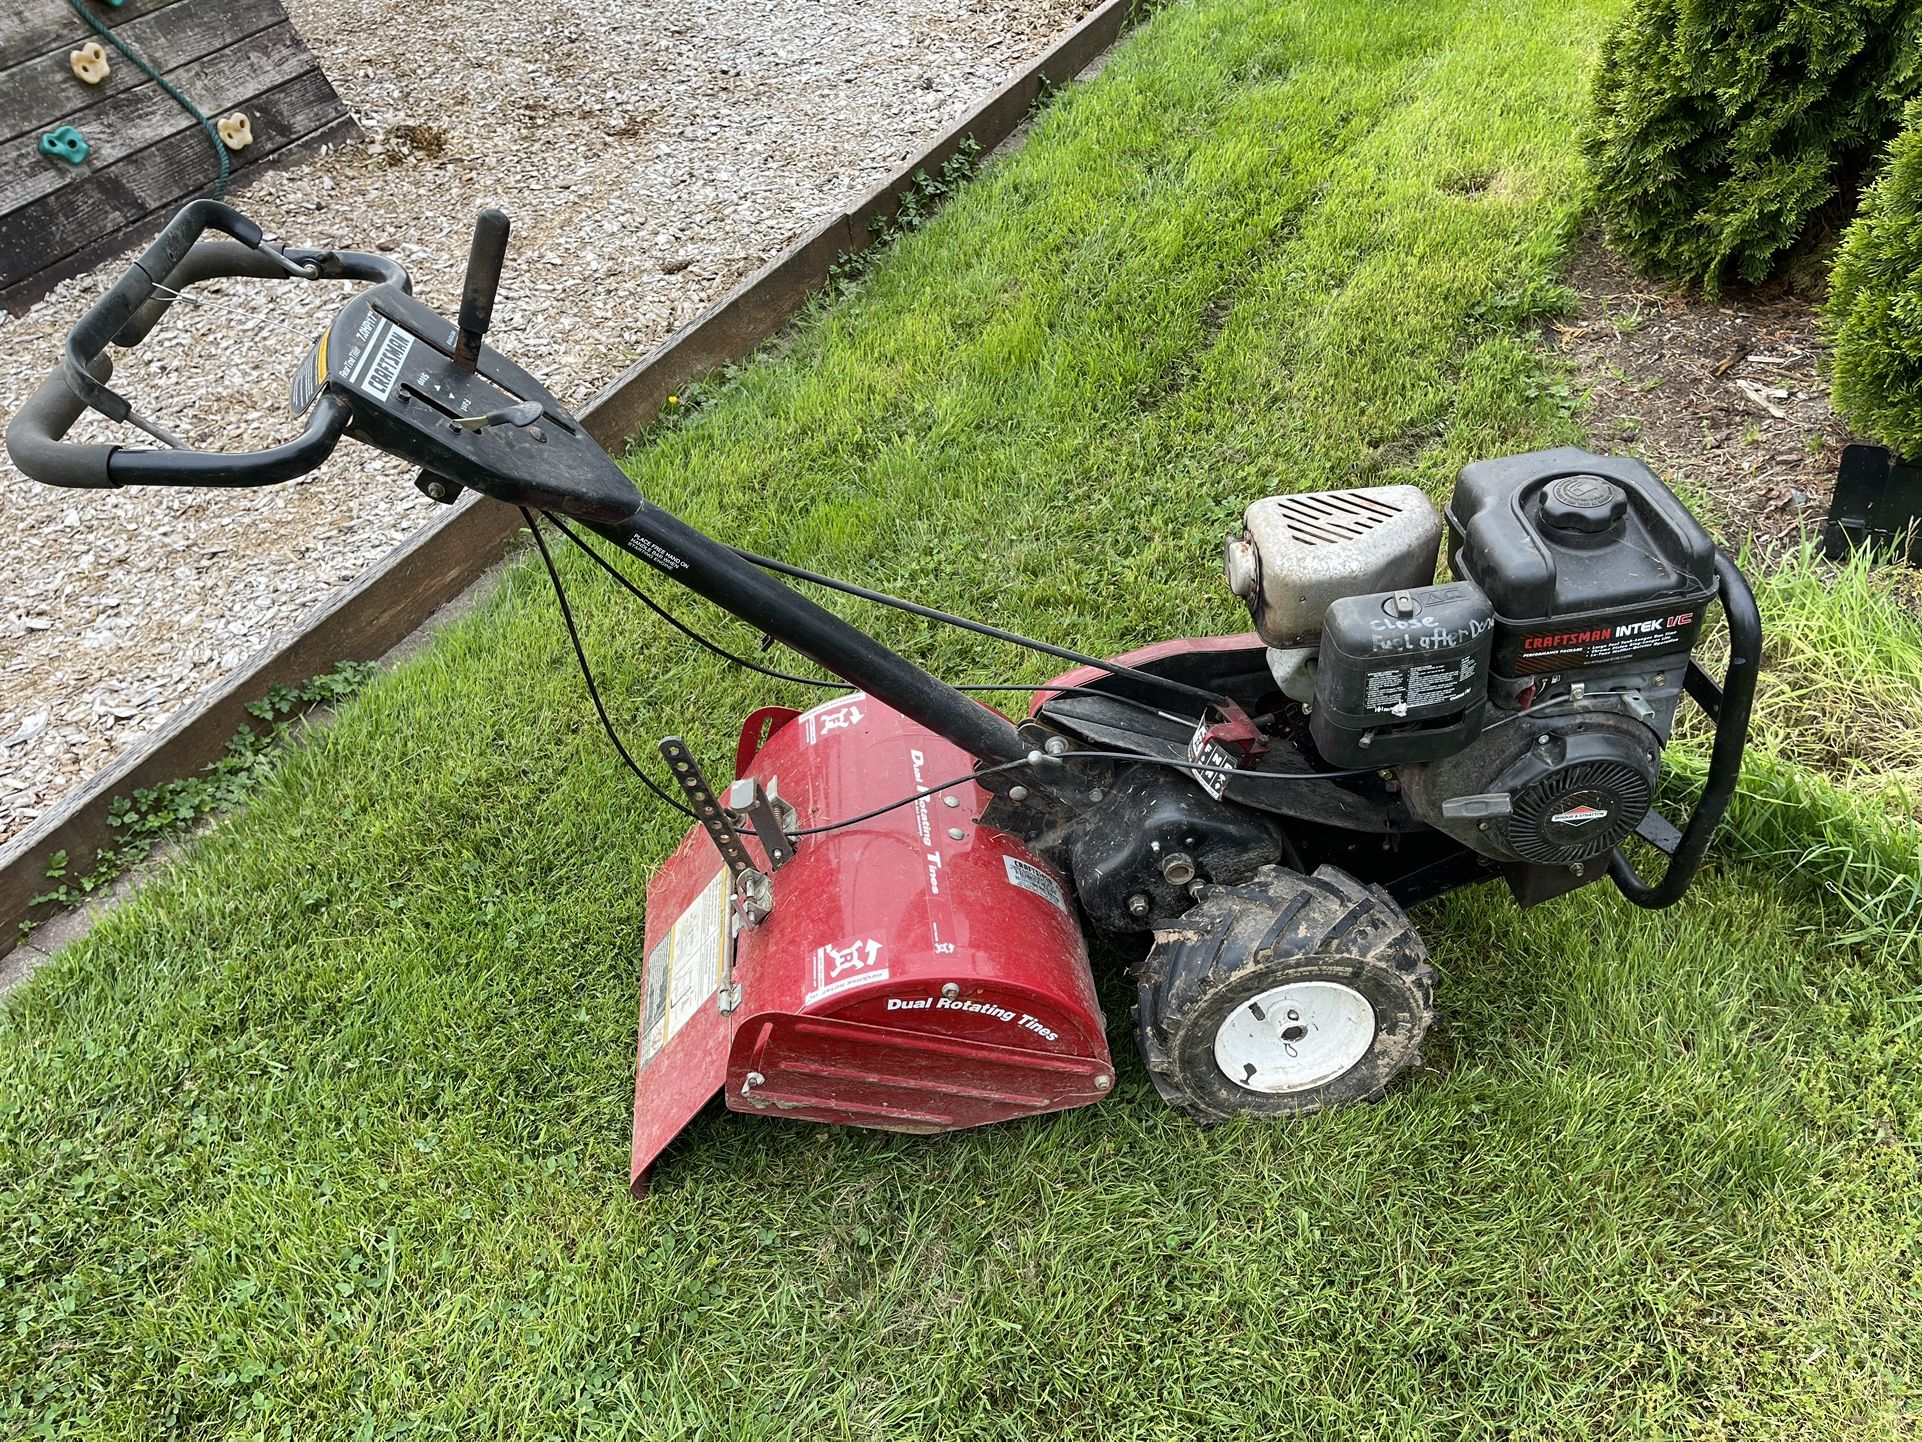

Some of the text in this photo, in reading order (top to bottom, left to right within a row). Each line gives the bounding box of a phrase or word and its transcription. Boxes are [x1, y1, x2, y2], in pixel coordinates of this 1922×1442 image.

[368, 331, 410, 394] CRAFTSMAN
[627, 541, 674, 570] STARTING ENGINE
[630, 537, 679, 569] HANDLE BAR WHEN
[633, 533, 690, 569] PLACE FREE HAND ON
[1524, 613, 1694, 649] CRAFTSMAN INTEK I/C
[910, 749, 925, 783] Dual
[1211, 752, 1223, 766] N
[916, 785, 932, 847] Rotating
[926, 850, 942, 894] Tines
[886, 997, 1059, 1042] Dual Rotating Tines
